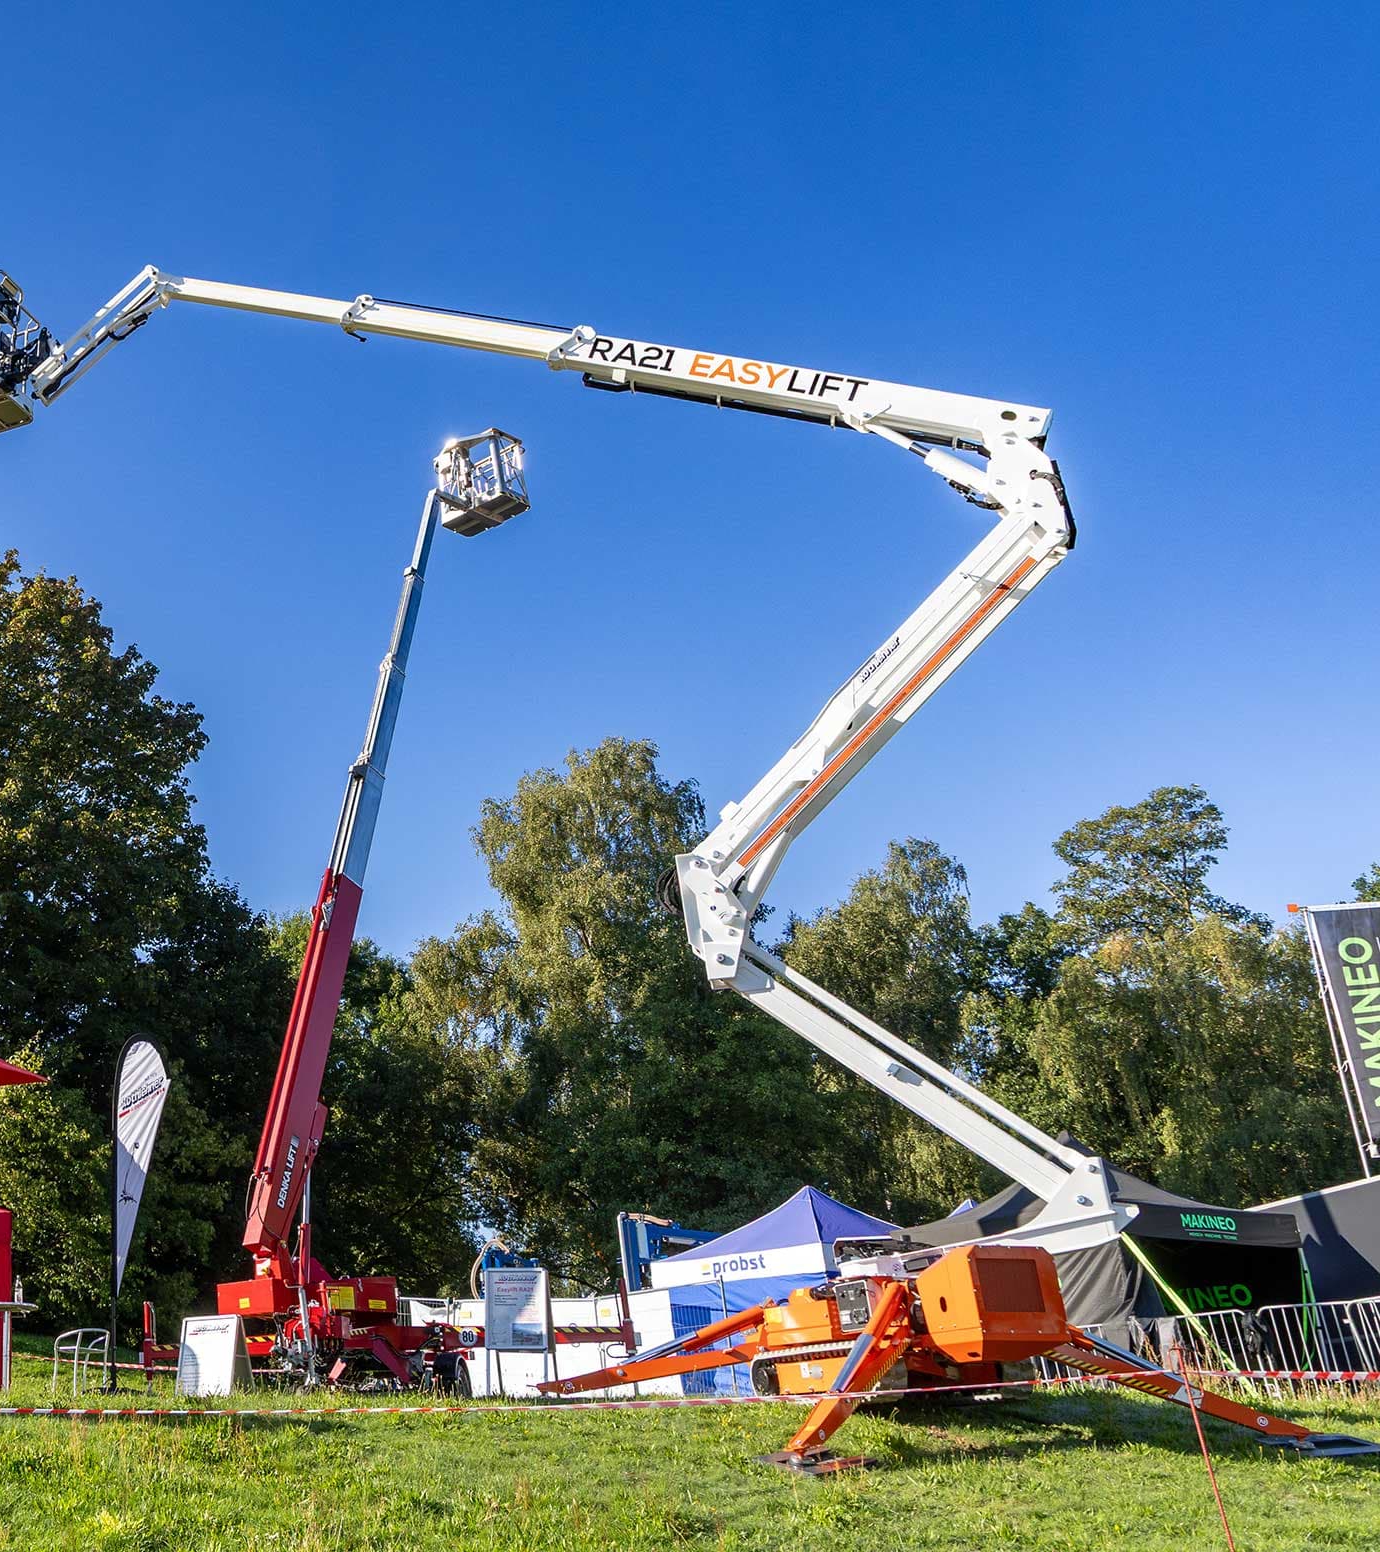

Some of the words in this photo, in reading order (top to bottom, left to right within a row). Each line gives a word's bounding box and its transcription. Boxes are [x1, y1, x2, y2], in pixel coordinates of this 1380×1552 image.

[588, 338, 675, 371] RA21
[688, 354, 869, 401] EASYLIFT
[277, 1170, 292, 1209] DENKA
[286, 1145, 297, 1169] LIFT
[1180, 1213, 1236, 1231] MAKINEO
[713, 1254, 766, 1278] probst
[462, 1330, 474, 1342] 80
